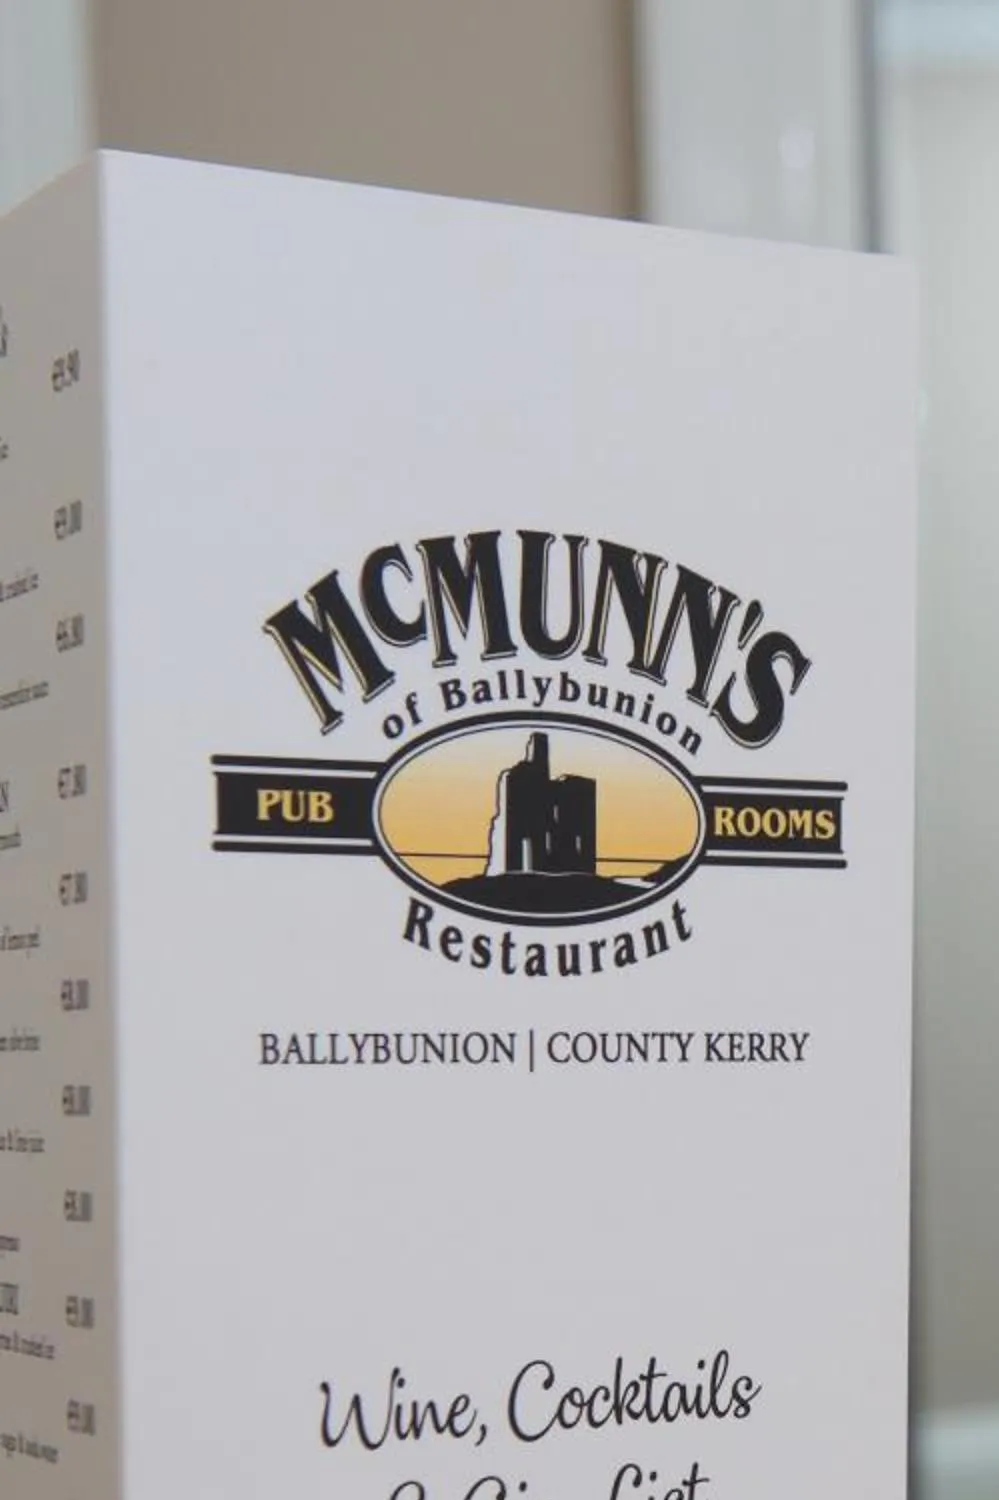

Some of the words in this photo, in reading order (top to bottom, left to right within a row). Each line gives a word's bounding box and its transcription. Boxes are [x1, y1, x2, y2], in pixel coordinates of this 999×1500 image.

[382, 691, 423, 740] of
[438, 668, 703, 757] Ballybunion
[256, 790, 334, 822] PUB
[713, 807, 836, 839] ROOMS
[402, 896, 692, 978] Restaurant
[259, 1031, 517, 1065] BALLYBUNION
[546, 1031, 695, 1064] COUNTY
[703, 1031, 811, 1063] KERRY
[319, 1366, 488, 1451] Wine,
[507, 1349, 763, 1443] Cocktails
